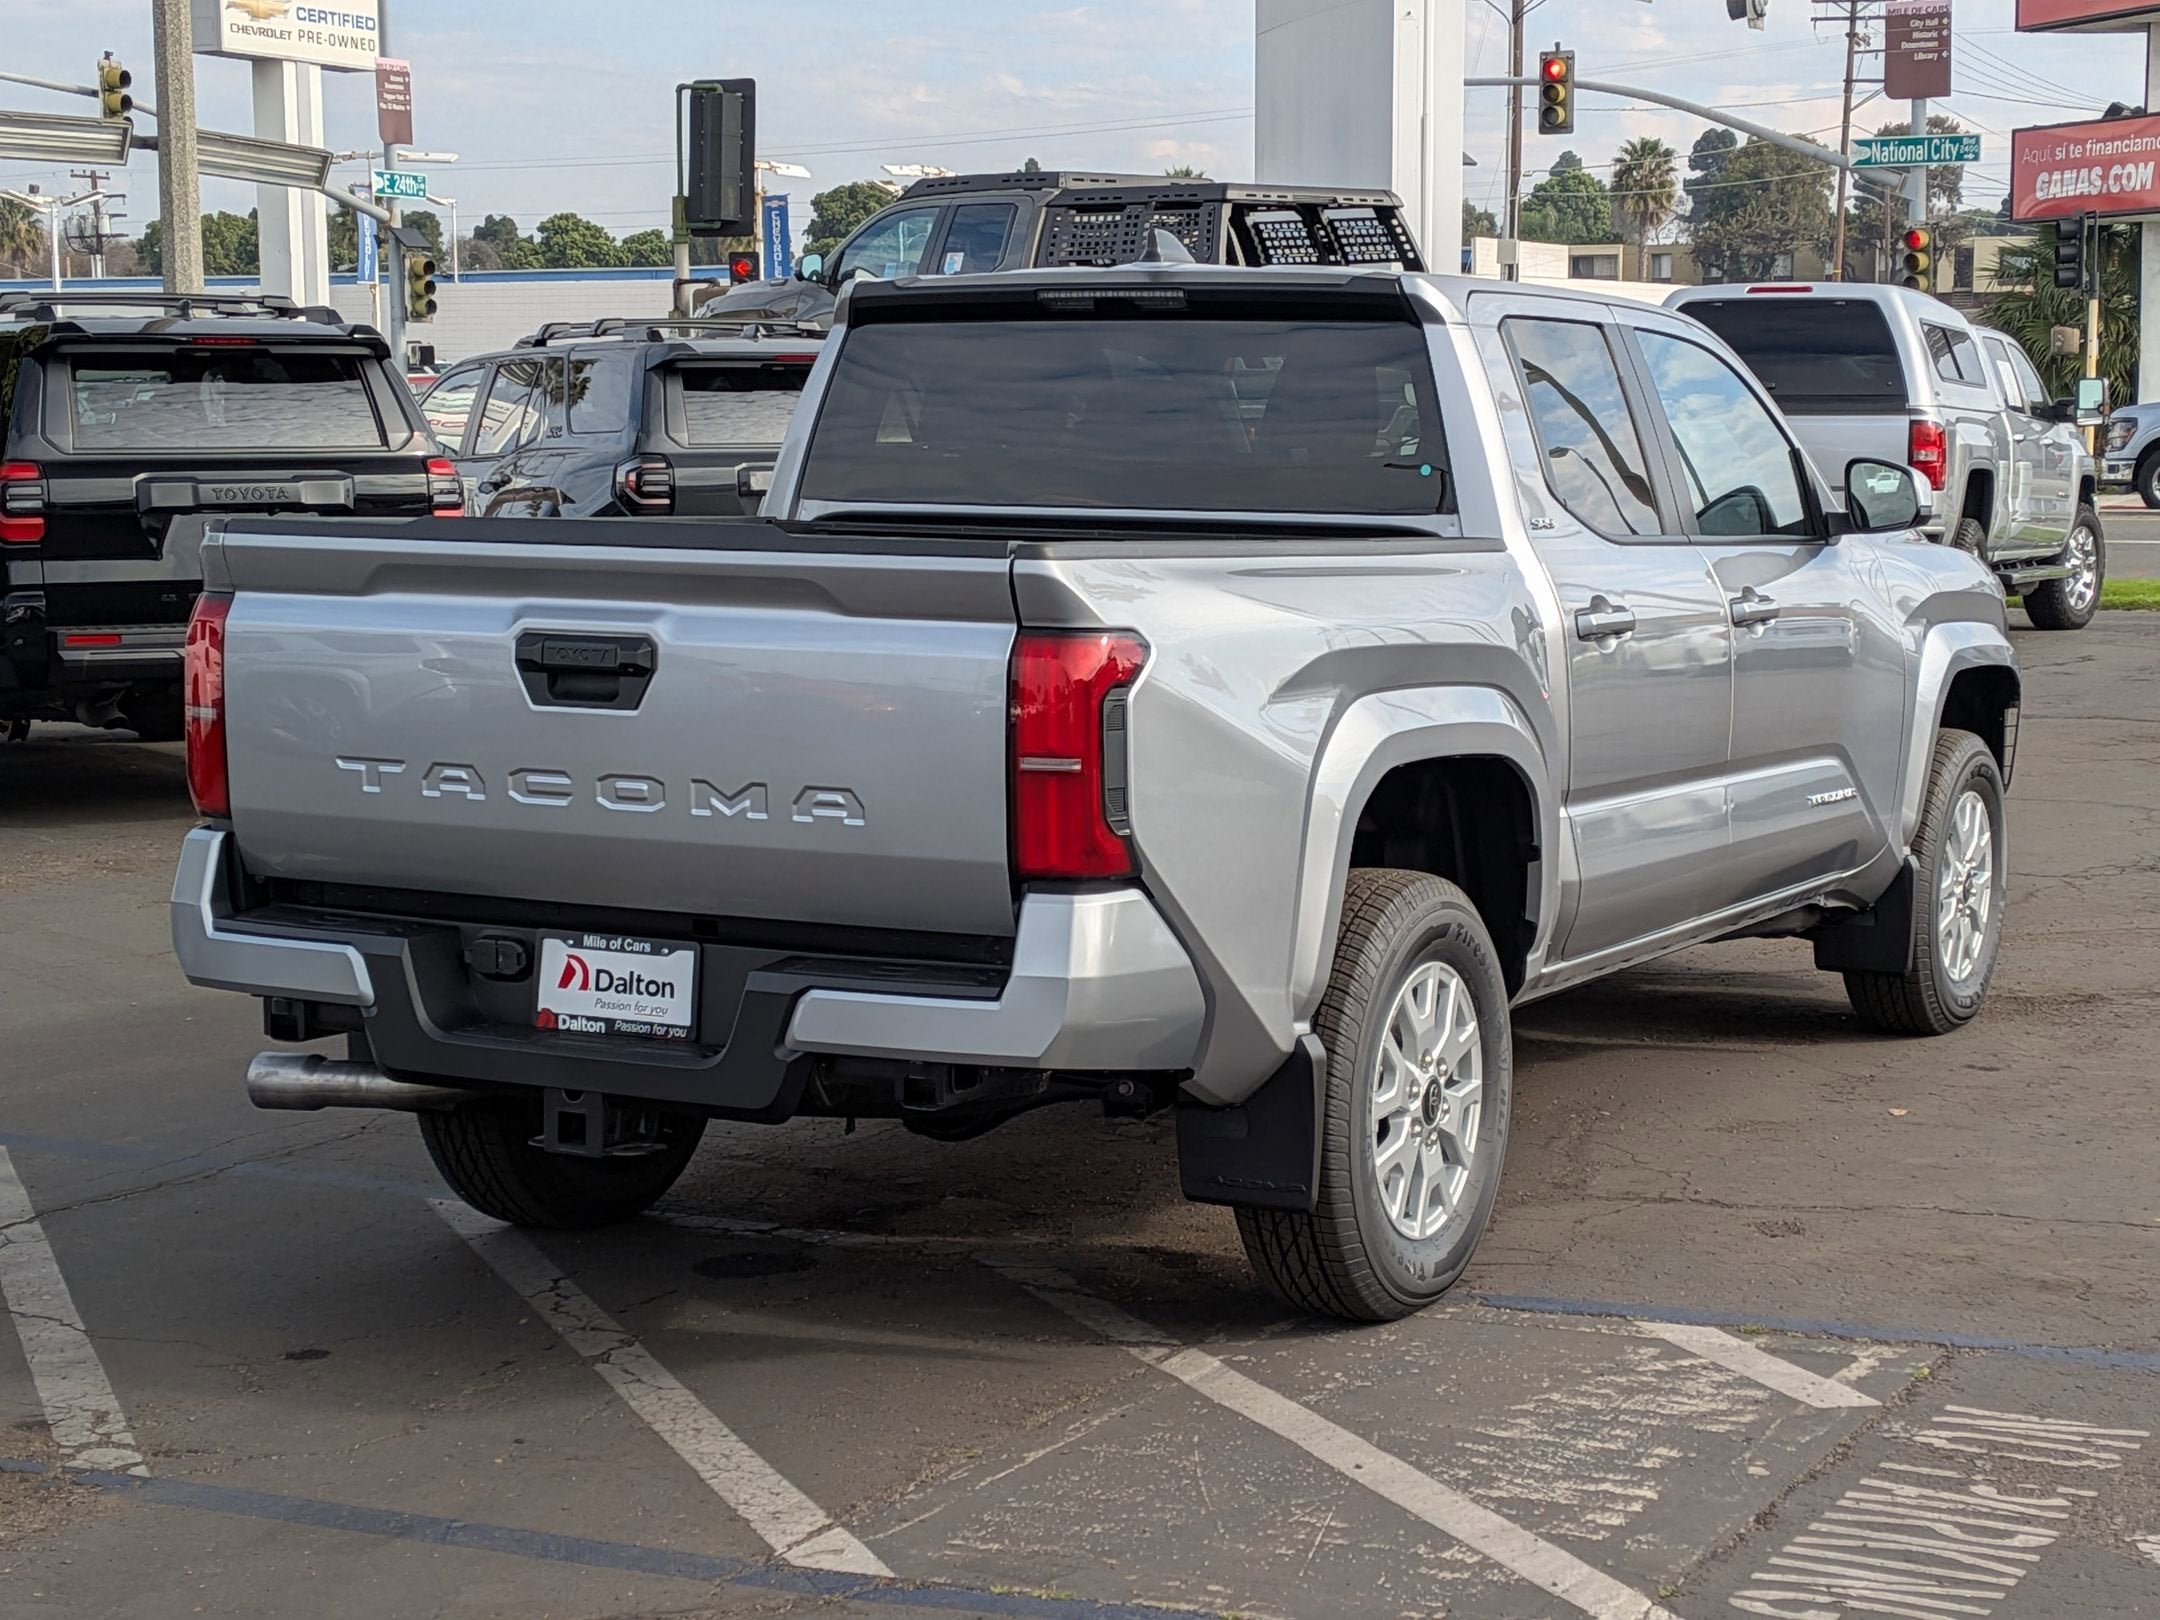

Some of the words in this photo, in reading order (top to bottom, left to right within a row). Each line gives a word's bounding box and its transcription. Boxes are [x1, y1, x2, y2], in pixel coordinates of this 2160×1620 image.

[296, 6, 376, 31] CERTIFIED
[1911, 6, 1923, 15] OF
[1925, 4, 1950, 14] CARS
[229, 22, 292, 41] CHEVROLET
[1910, 18, 1925, 29] City
[298, 29, 376, 52] PRE-OWNED
[1914, 52, 1939, 61] Library
[1959, 144, 1979, 154] 2400
[1962, 136, 1977, 145] Blvd
[1871, 140, 1928, 163] National
[1931, 138, 1960, 161] City
[2055, 143, 2066, 161] sí
[2069, 143, 2083, 159] te
[383, 174, 393, 193] E
[393, 174, 417, 195] 24th
[771, 210, 783, 279] CHEVROLE
[211, 486, 290, 501] TOYOTA
[335, 754, 866, 826] TACOMA
[583, 934, 606, 949] Mile
[609, 937, 622, 950] of
[623, 939, 651, 953] Cars
[595, 968, 675, 999] Dalton
[594, 997, 632, 1012] Passion
[633, 1000, 650, 1014] for
[649, 1004, 669, 1016] you
[558, 1014, 606, 1034] Dalton
[614, 1020, 651, 1035] Passion
[651, 1025, 667, 1036] for
[667, 1027, 687, 1038] you
